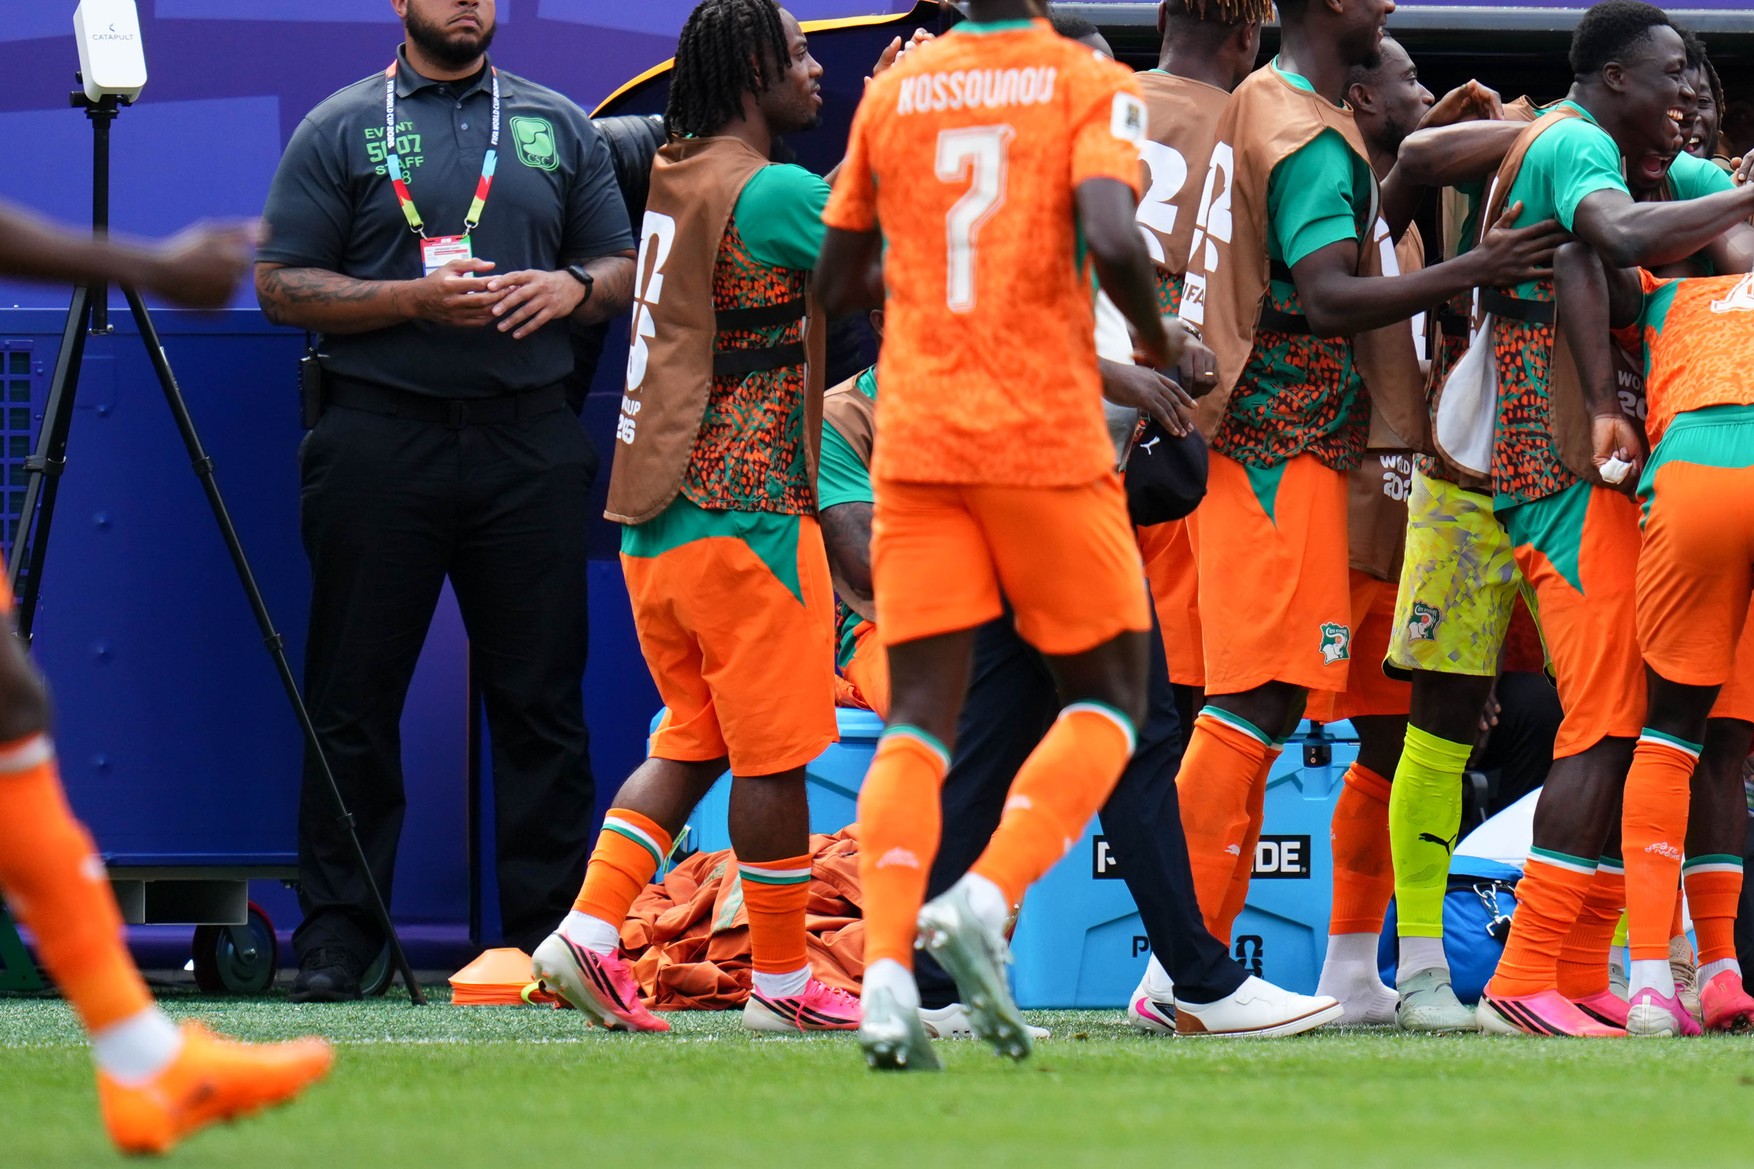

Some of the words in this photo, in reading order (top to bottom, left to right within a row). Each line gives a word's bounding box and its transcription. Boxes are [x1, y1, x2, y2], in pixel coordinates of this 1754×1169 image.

[897, 66, 1056, 115] KOSSOUNOU
[364, 121, 413, 139] EVNT
[375, 156, 424, 175] SAFF
[934, 123, 1017, 312] 7
[1182, 282, 1205, 307] IFA
